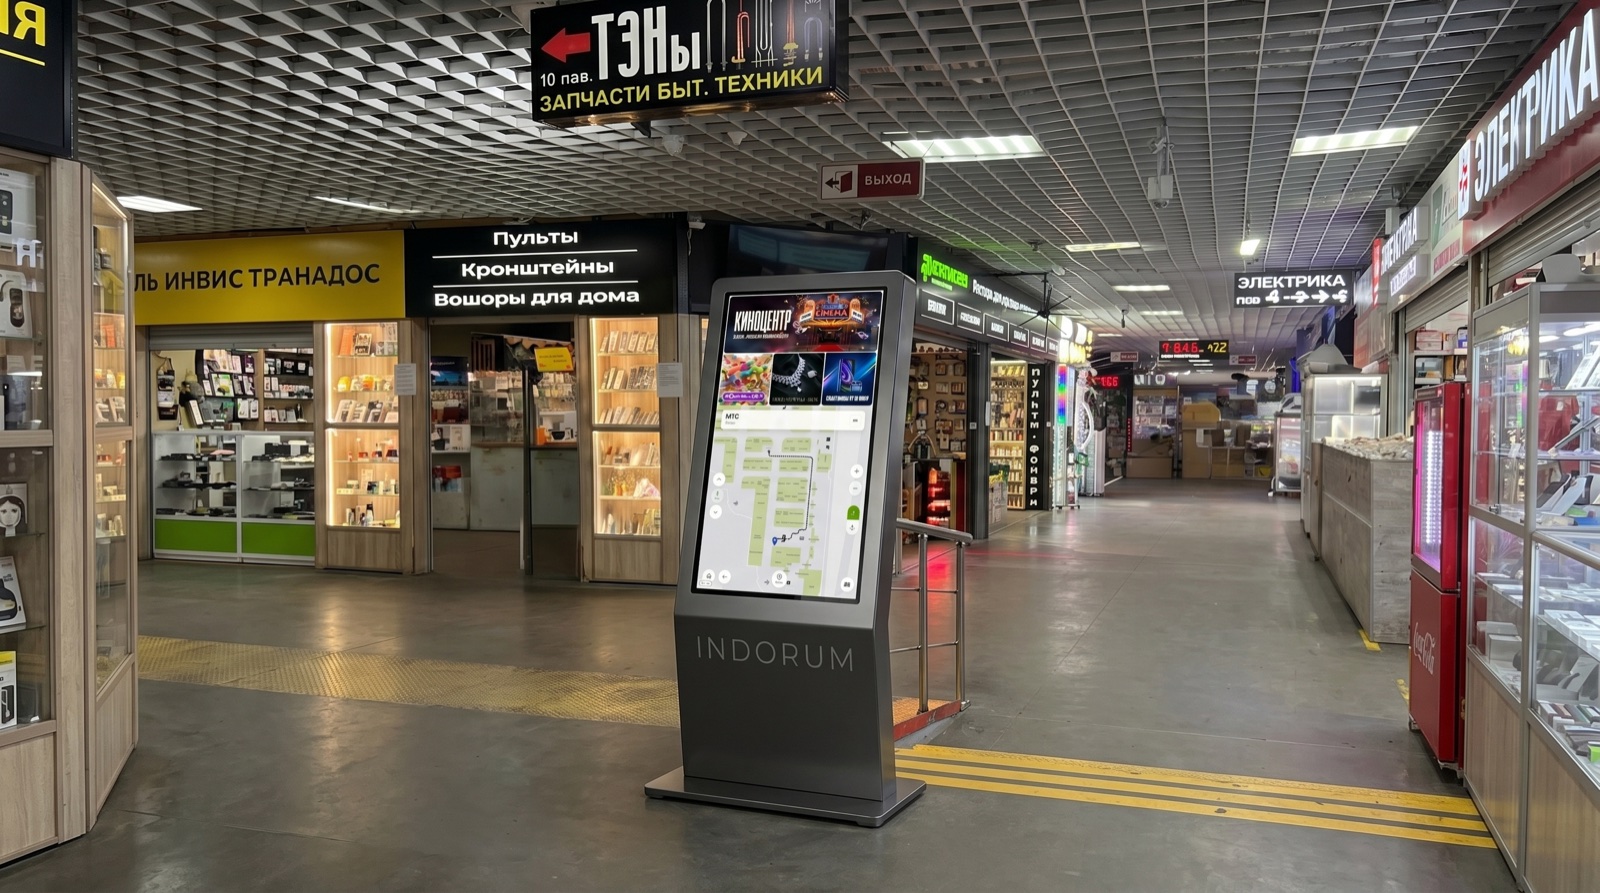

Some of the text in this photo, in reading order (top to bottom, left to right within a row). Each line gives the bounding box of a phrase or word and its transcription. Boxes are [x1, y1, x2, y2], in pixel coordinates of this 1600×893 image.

[0, 0, 46, 47] Я
[591, 5, 700, 80] ТЭНы
[540, 71, 593, 87] 10 пав.
[540, 65, 823, 112] ЗАПЧАСТИ БЫТ. ТЕХНИКИ
[1474, 8, 1599, 202] ЭЛЕКТРИКА
[864, 172, 912, 186] ВЫХОД
[493, 231, 579, 248] Пульты
[165, 269, 243, 291] ИНВИС
[248, 263, 380, 288] ТРАНАДОС
[461, 259, 614, 280] Кронштейны
[1238, 274, 1346, 289] ЭЛЕКТРИКА
[434, 290, 640, 308] Вошоры для дома
[734, 309, 792, 333] КИНОЦЕНТР
[815, 309, 848, 317] CINEMA
[696, 635, 853, 672] INDORUM
